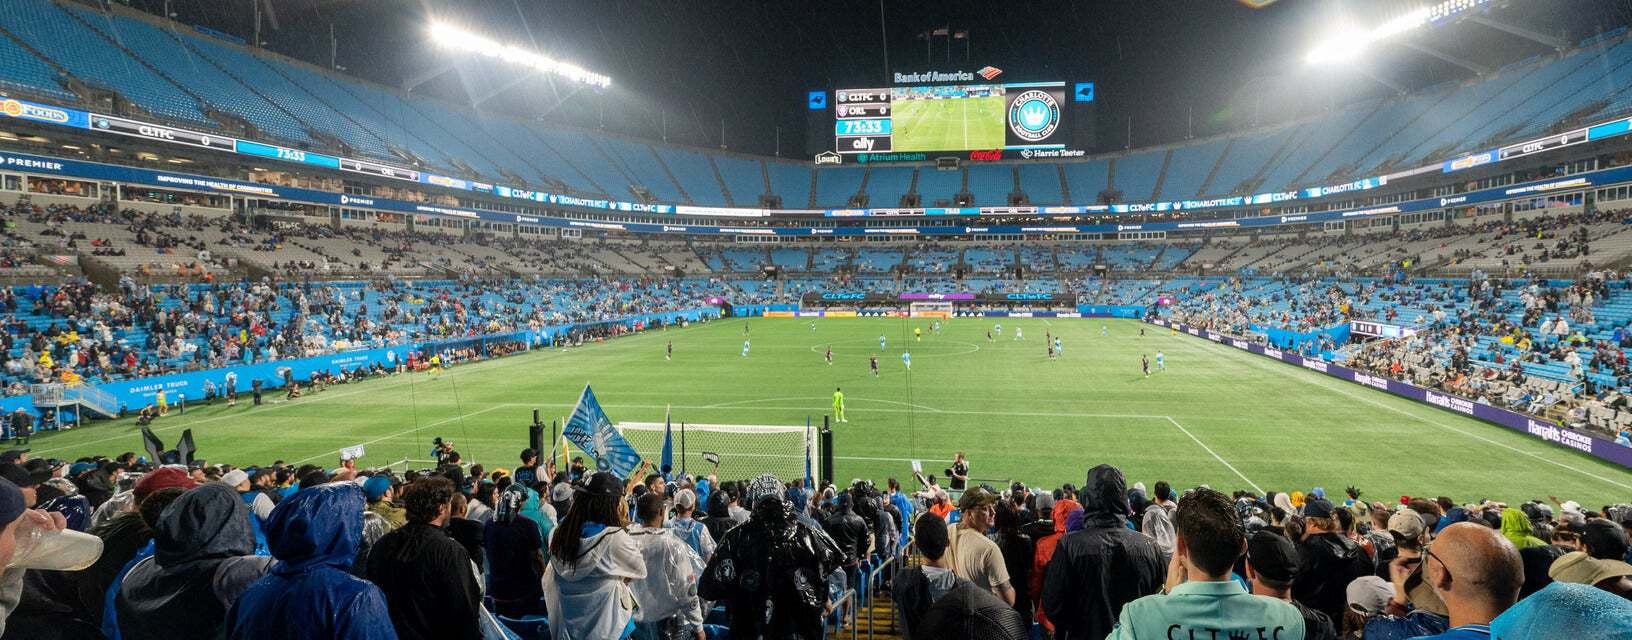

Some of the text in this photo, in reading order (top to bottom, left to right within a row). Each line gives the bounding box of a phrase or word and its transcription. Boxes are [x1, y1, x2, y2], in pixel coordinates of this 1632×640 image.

[894, 70, 974, 83] Bank of America
[848, 92, 886, 101] CLTFC 0
[1015, 91, 1055, 107] CHARLOTTE
[848, 106, 886, 115] ORL 0
[845, 120, 882, 134] 73:33
[139, 125, 210, 146] CLTFC 0
[1561, 135, 1568, 144] 0
[853, 137, 875, 151] ally
[277, 148, 305, 162] 73:33
[870, 152, 926, 161] Atrium Health
[1034, 149, 1058, 158] Harris
[8, 157, 62, 171] PREMIER
[158, 175, 193, 185] IMPROVING
[130, 383, 163, 393] DAIMLER
[1528, 419, 1592, 446] Harrah's CHEROKEE
[1561, 437, 1592, 453] CASINOS
